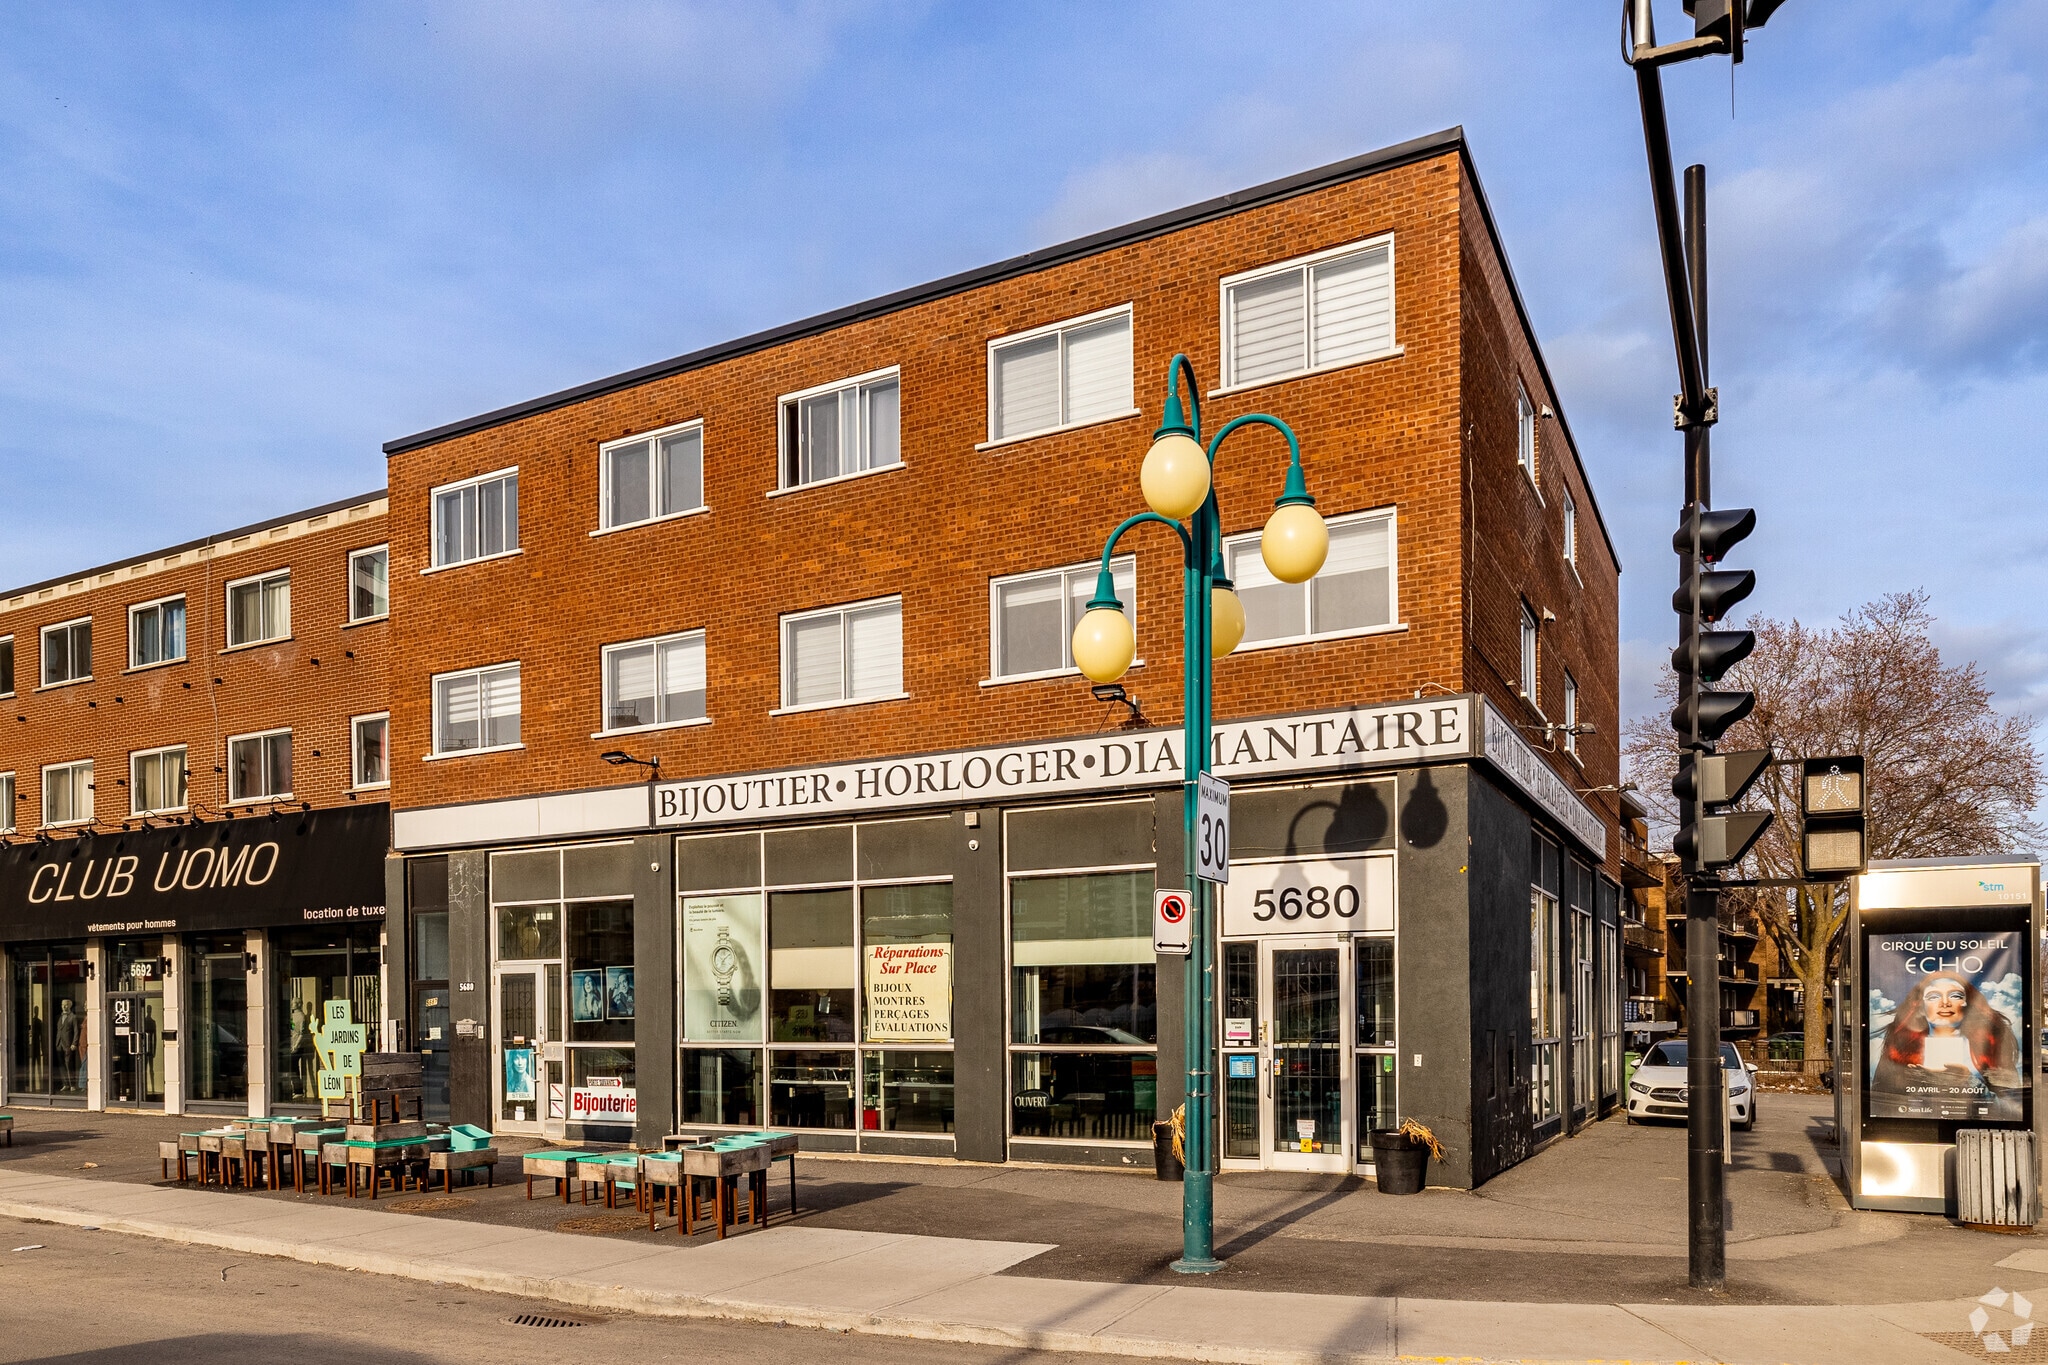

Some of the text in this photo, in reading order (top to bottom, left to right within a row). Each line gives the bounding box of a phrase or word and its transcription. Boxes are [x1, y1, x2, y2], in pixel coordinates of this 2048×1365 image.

[1491, 715, 1533, 787] BIJOUTIER
[658, 773, 834, 821] BIJOUTIER
[854, 747, 1081, 799] HORLOGER
[1201, 784, 1228, 807] MAXIMUM
[1200, 813, 1226, 871] 30
[28, 842, 280, 904] CLUB UOMO
[1983, 882, 2004, 892] stm
[1252, 884, 1360, 922] 5680
[303, 905, 387, 920] location de tuxe
[87, 919, 176, 932] vêtements pour hommes
[874, 945, 944, 962] Réparations
[1881, 939, 2009, 954] CIRQUE DU SOLEIL
[130, 963, 152, 977] 5692
[880, 961, 937, 975] Sur Place
[873, 983, 912, 993] BIJOUX
[873, 996, 925, 1006] MONTRES
[332, 1006, 345, 1019] LES
[874, 1009, 930, 1020] PERÇAGES
[709, 1020, 737, 1028] CITIZEN
[874, 1020, 948, 1033] ÉVALUATIONS
[330, 1030, 360, 1044] JARDINS
[343, 1054, 353, 1068] DE
[323, 1074, 341, 1090] LÉON
[1961, 1086, 1984, 1094] AOÛT
[573, 1092, 637, 1116] Bijouterie
[1014, 1095, 1047, 1108] OUVERT
